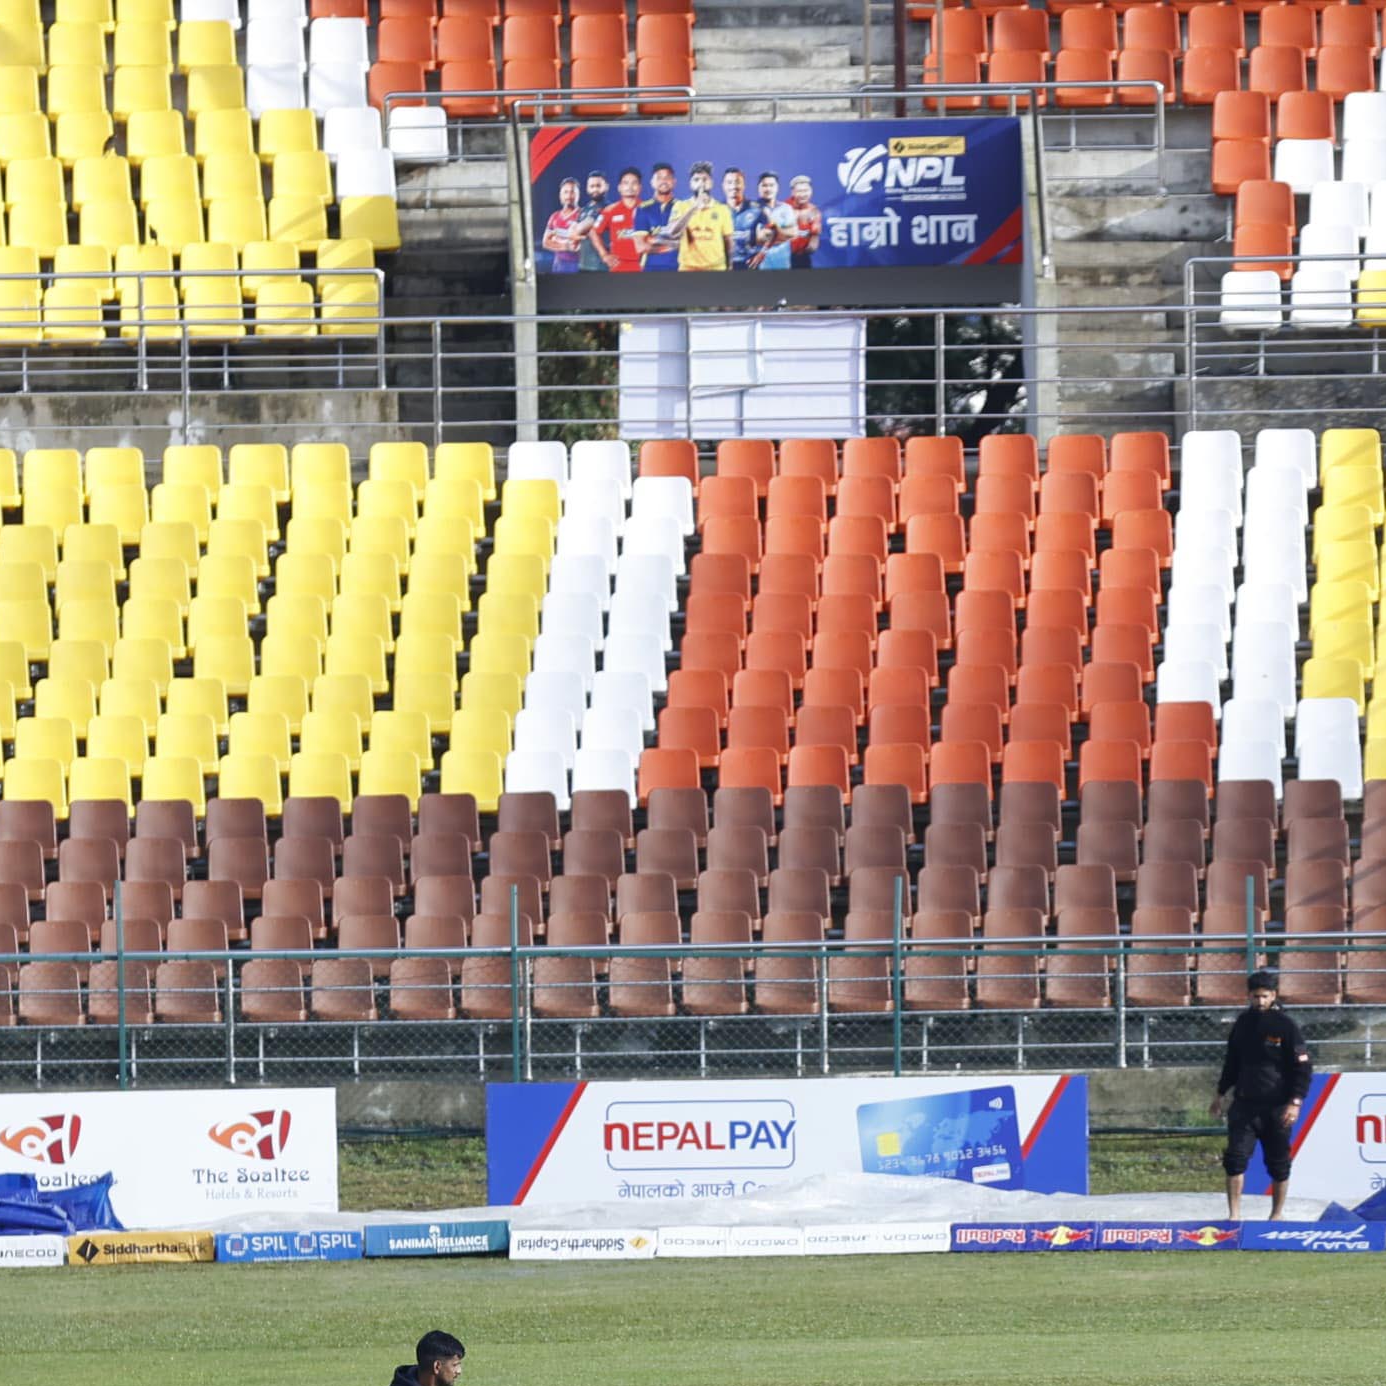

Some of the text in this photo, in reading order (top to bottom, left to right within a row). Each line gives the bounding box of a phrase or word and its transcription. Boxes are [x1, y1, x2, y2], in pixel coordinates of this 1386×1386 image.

[884, 157, 966, 188] NPL
[826, 206, 979, 249] हाम्रो शान
[192, 1167, 310, 1184] The Soaltee
[251, 1233, 357, 1251] SPIL SPIL
